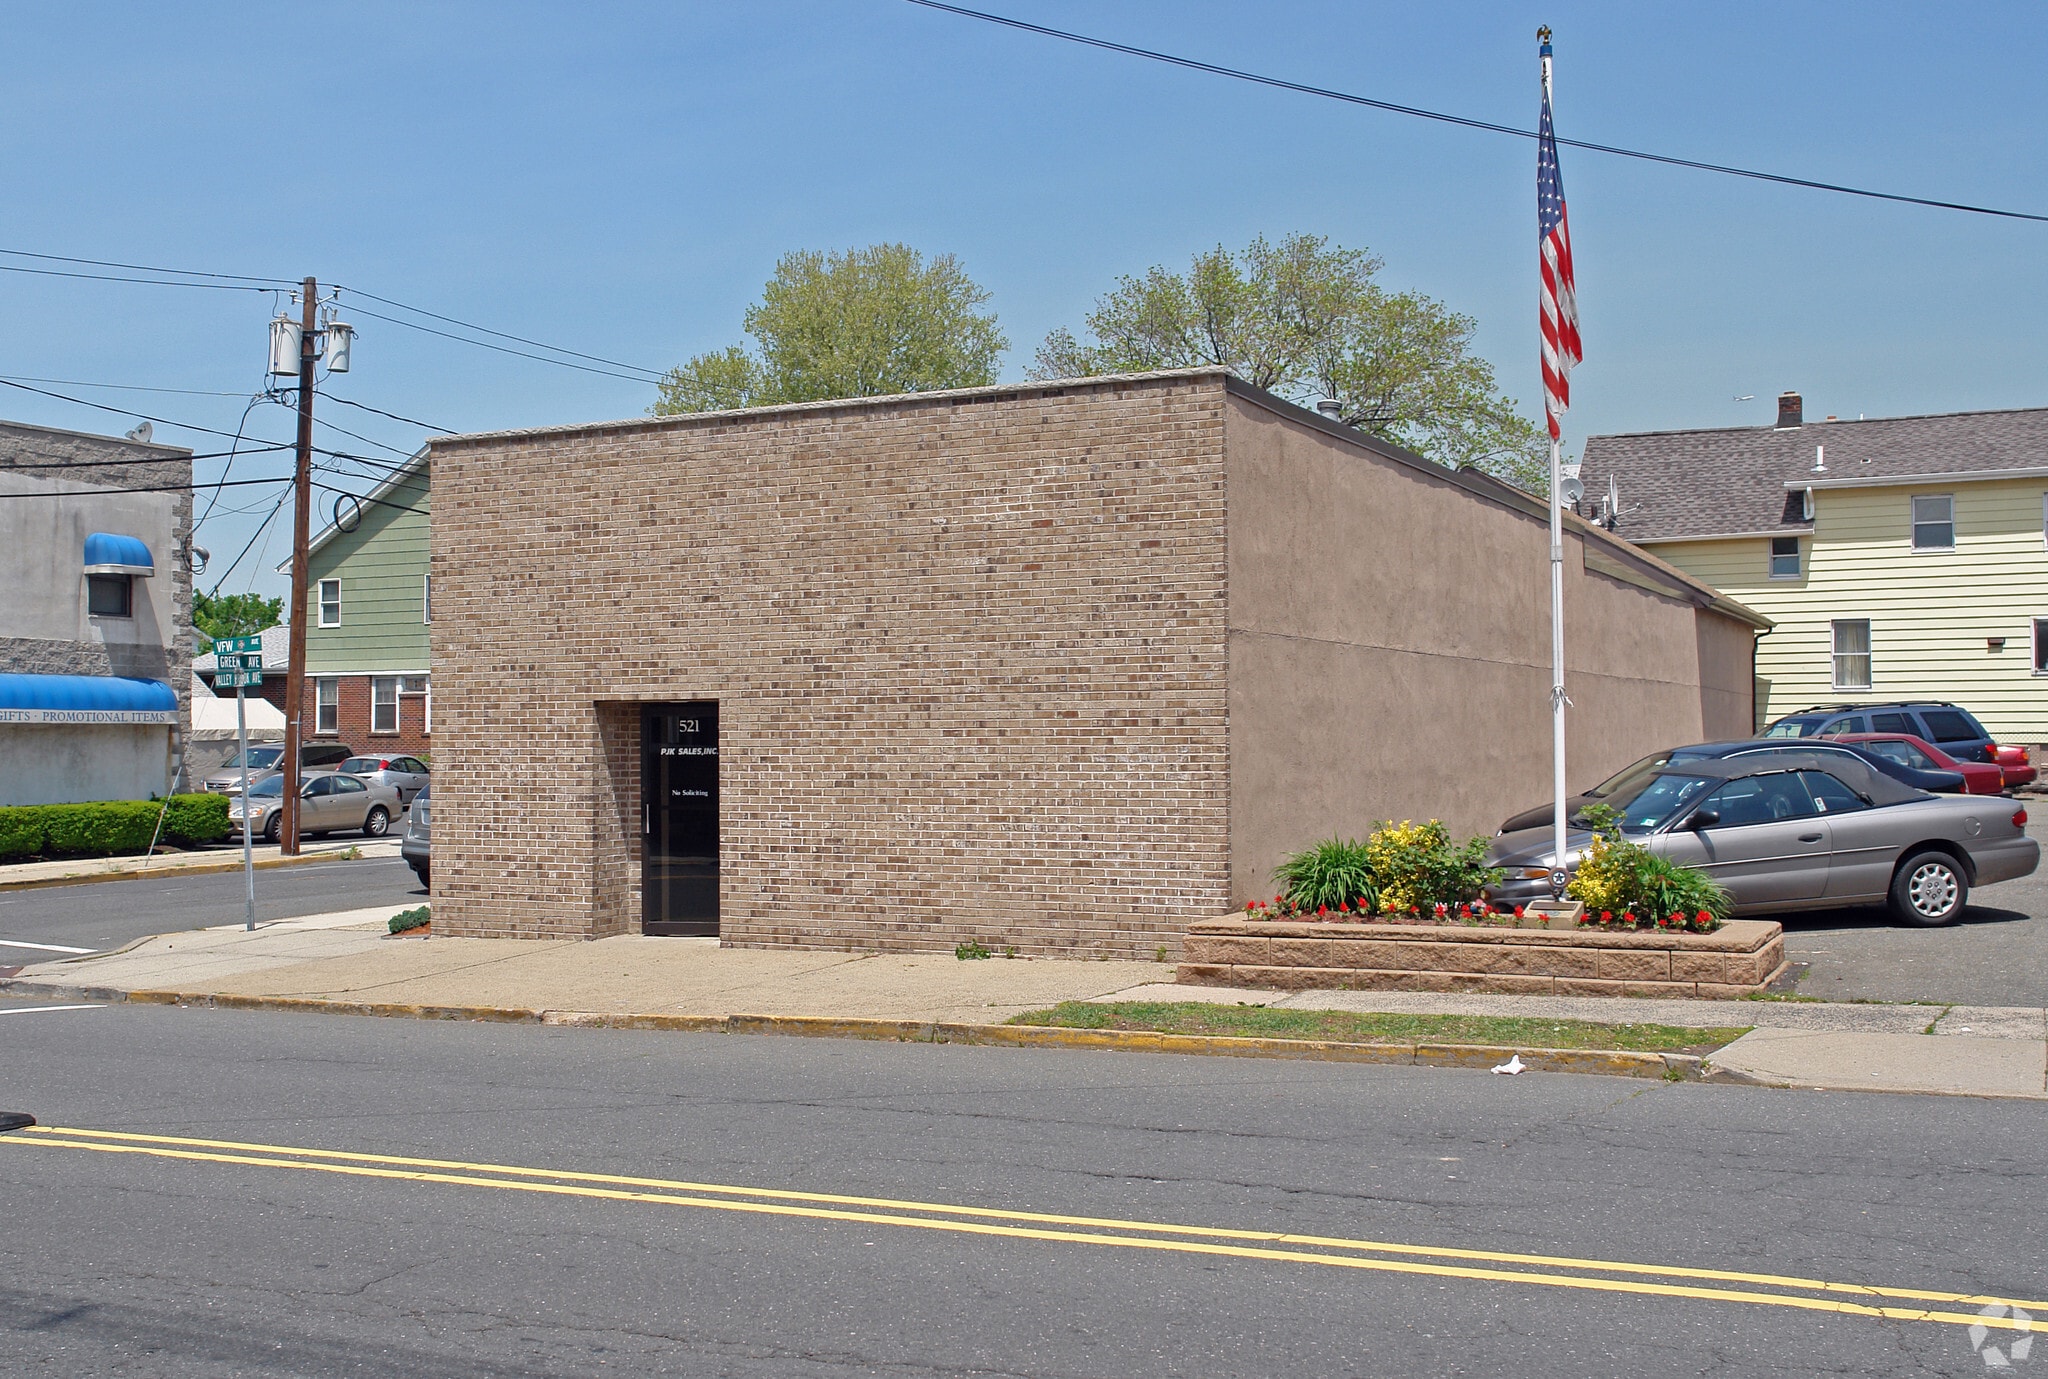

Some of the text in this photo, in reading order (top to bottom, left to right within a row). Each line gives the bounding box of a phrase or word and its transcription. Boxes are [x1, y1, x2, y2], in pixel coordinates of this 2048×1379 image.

[216, 640, 233, 653] VFW
[248, 656, 260, 668] AVE
[215, 674, 232, 686] VALLEY
[252, 671, 261, 683] AVE
[42, 711, 128, 722] PROMOTIONAL
[131, 712, 165, 723] ITEMS
[679, 720, 699, 732] 521
[660, 747, 675, 755] PJK
